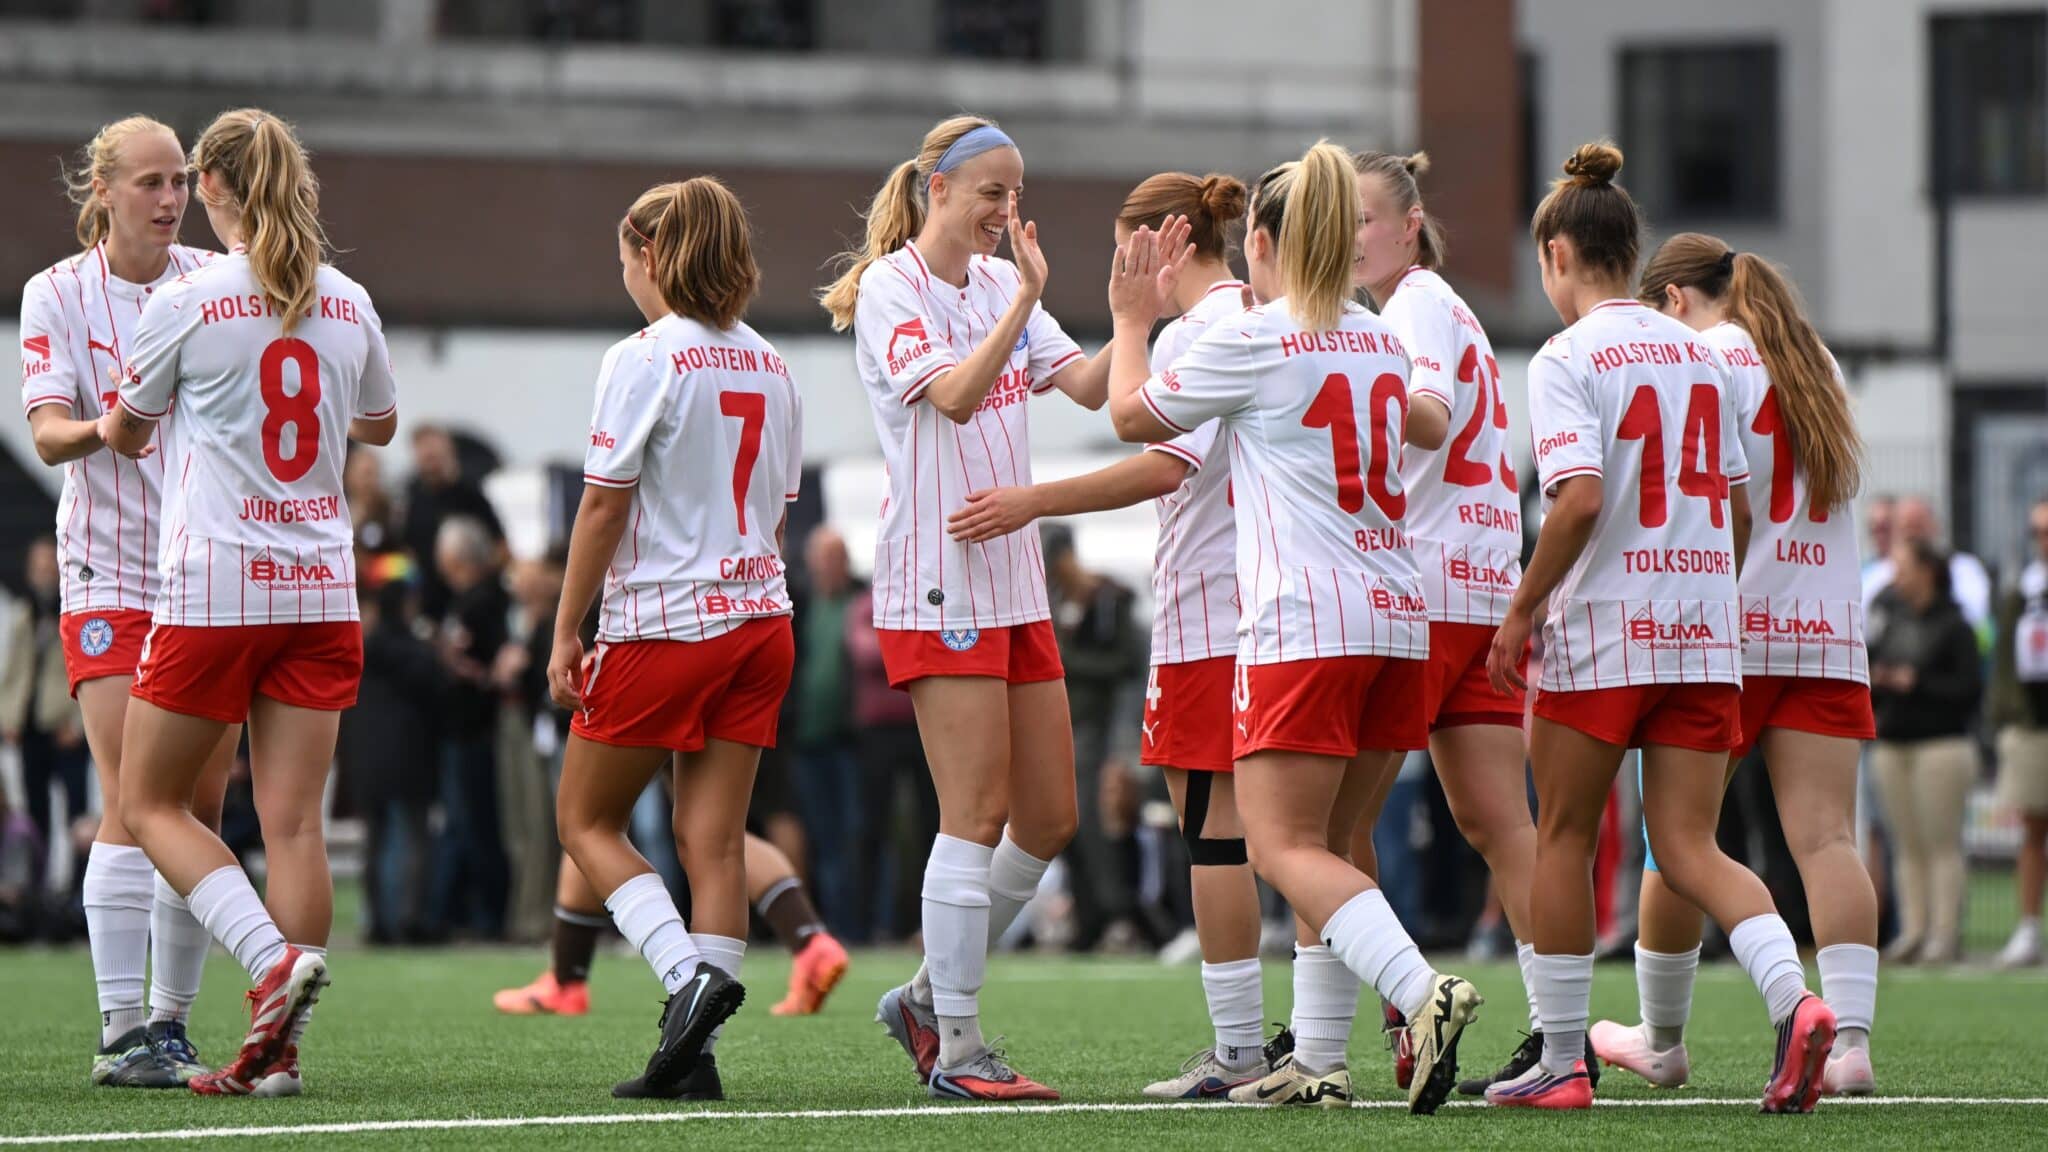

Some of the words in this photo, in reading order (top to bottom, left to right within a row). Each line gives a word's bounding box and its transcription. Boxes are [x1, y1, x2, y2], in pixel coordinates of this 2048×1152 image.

[202, 295, 312, 325] HOLST
[320, 295, 360, 325] KIEL
[889, 341, 931, 376] Budde
[1280, 331, 1378, 357] HOLSTEIN
[1590, 342, 1682, 374] HOLSTEIN
[671, 346, 758, 375] HOLSTEIN
[260, 337, 321, 483] 8
[1443, 343, 1519, 494] 25
[1301, 373, 1409, 521] 10
[1617, 383, 1728, 529] 14
[719, 390, 766, 536] 7
[1458, 503, 1520, 534] REDANT
[720, 554, 782, 580] CARONE
[1623, 550, 1731, 576] TOLKSDORF
[1776, 539, 1826, 566] LAKO
